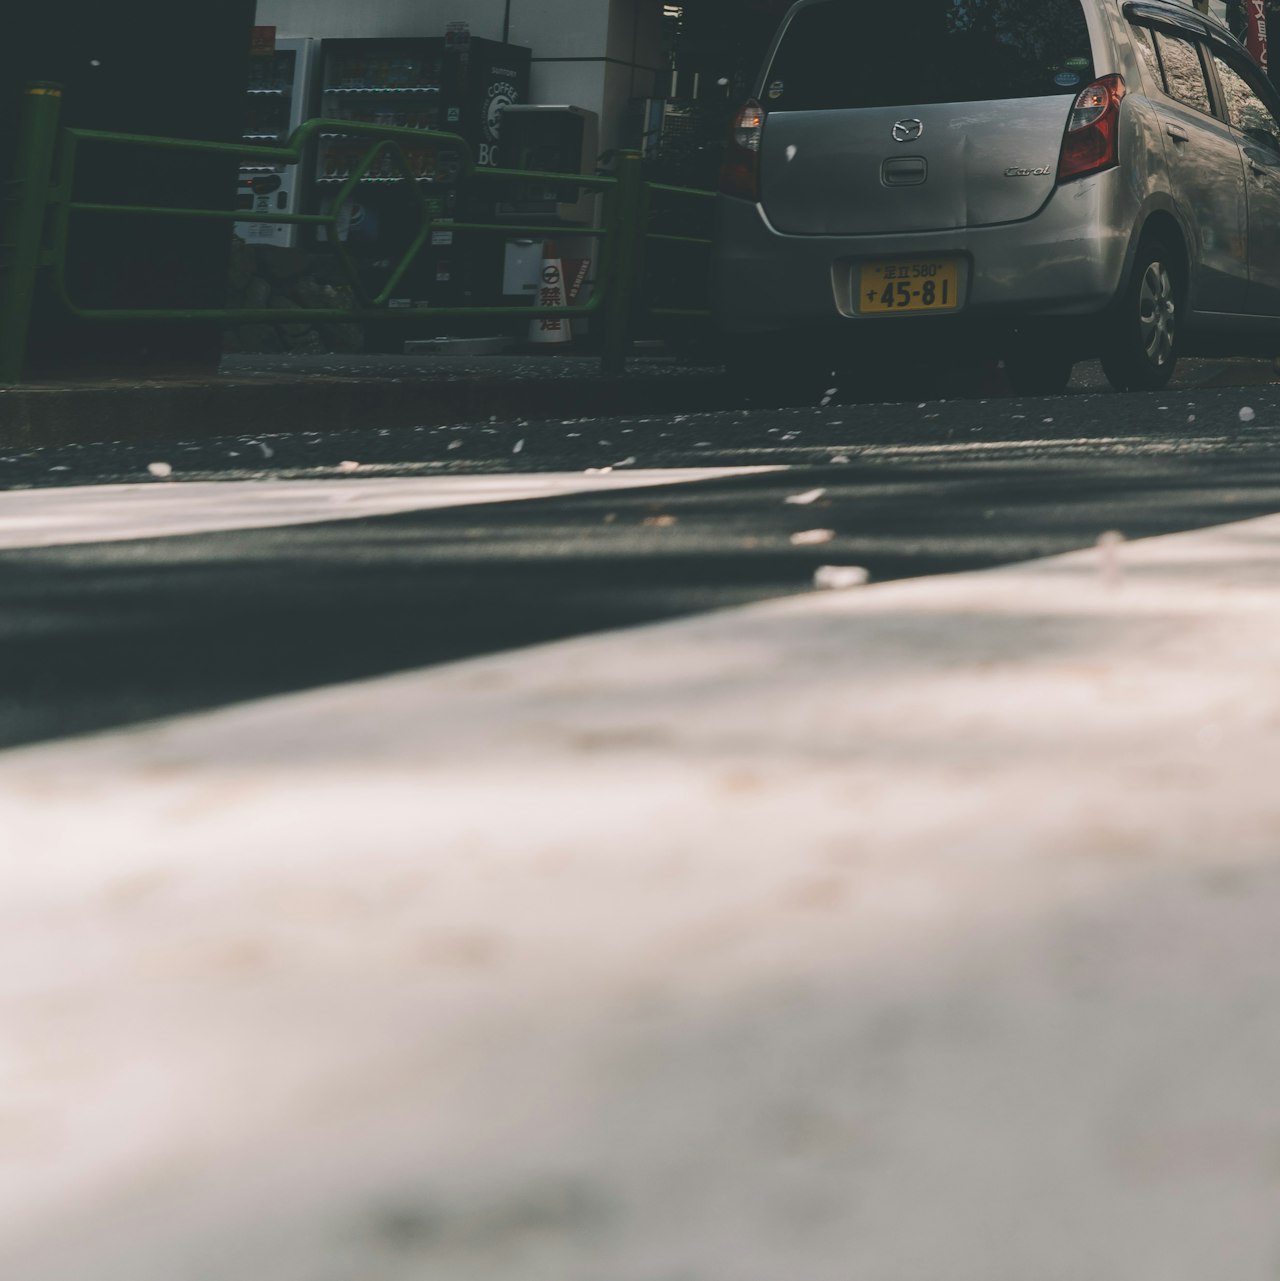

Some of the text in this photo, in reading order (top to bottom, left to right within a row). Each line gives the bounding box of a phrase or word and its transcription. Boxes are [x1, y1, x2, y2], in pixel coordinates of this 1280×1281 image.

[488, 81, 518, 102] COFFEE
[1004, 164, 1051, 177] Carol
[880, 280, 948, 307] 45-81
